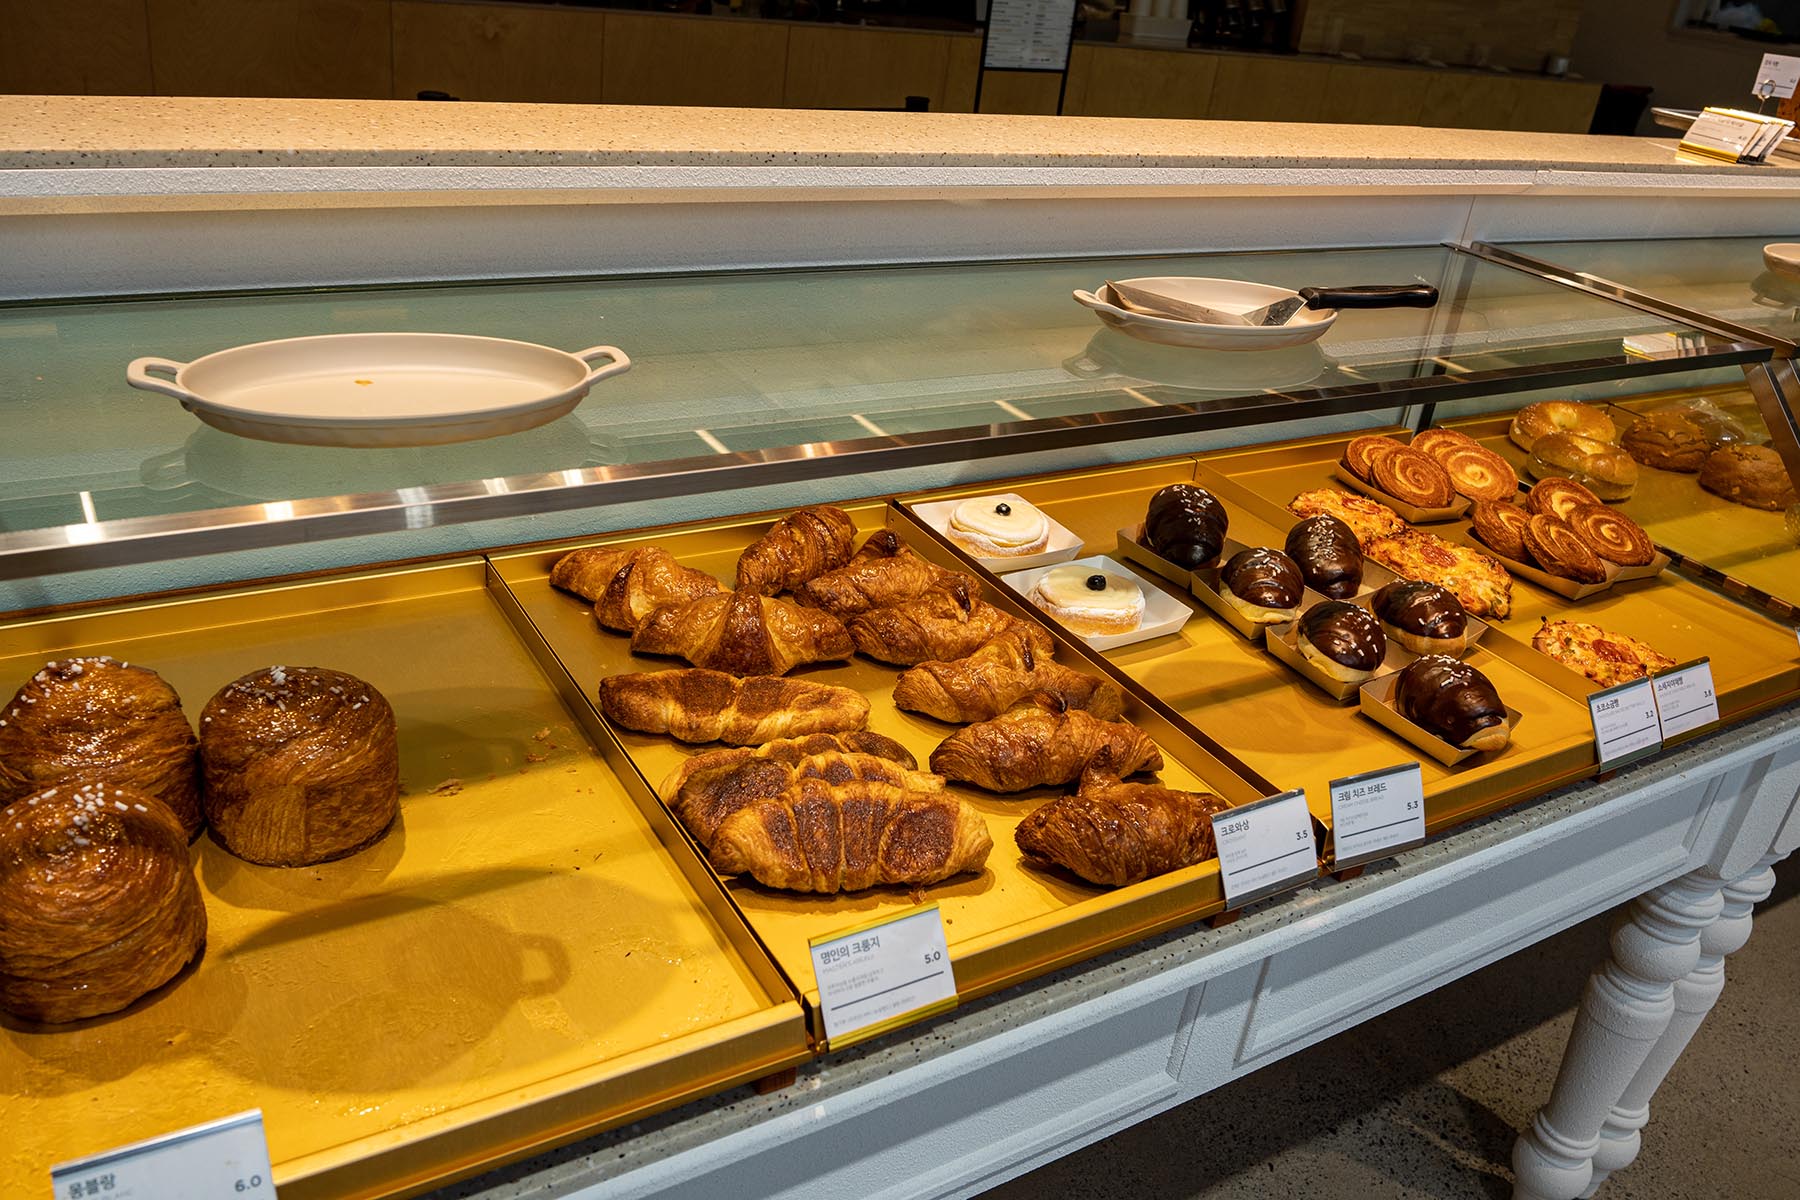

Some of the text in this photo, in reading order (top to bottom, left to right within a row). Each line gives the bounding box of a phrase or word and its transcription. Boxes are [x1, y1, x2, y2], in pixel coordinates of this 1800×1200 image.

[1338, 790, 1351, 802] 크림
[1352, 787, 1366, 798] 치즈
[1367, 782, 1387, 795] 브레드
[1407, 800, 1418, 810] 5.3
[1221, 819, 1250, 837] 크로와상
[1296, 830, 1308, 841] 3.5
[820, 945, 850, 965] 명인의
[924, 951, 941, 964] 5.0
[68, 1173, 116, 1199] 몽블랑
[235, 1175, 262, 1192] 6.0
